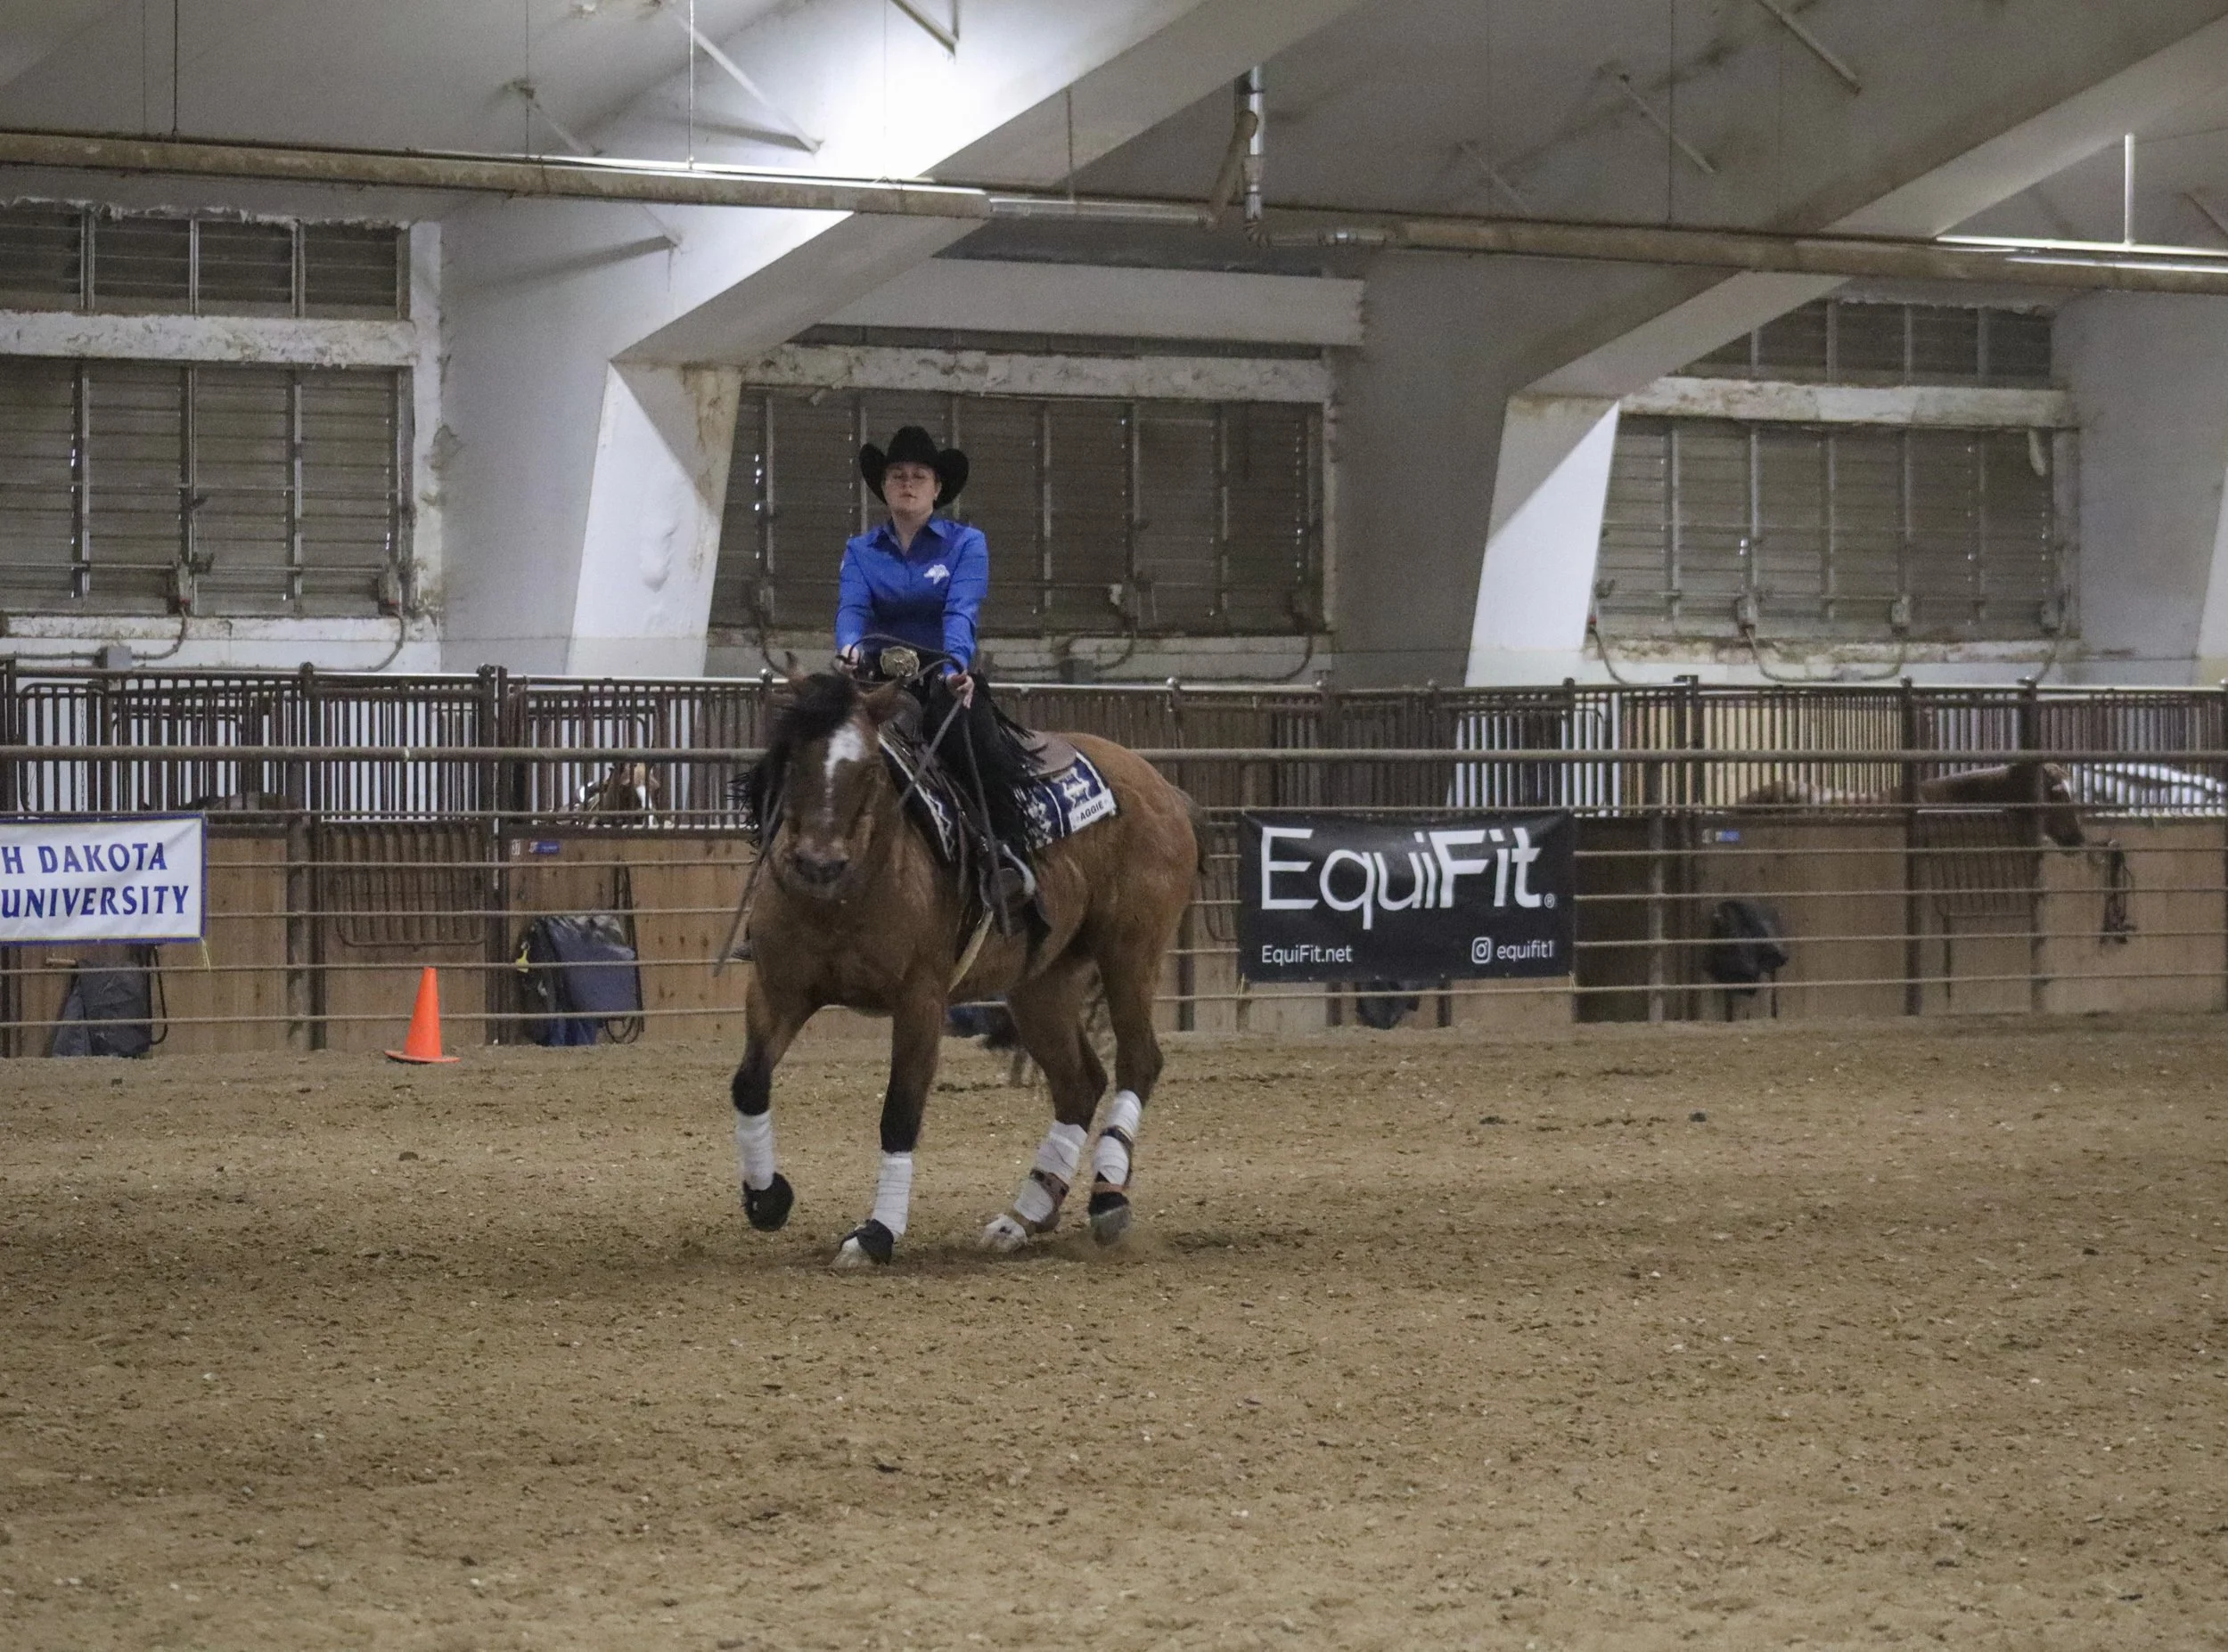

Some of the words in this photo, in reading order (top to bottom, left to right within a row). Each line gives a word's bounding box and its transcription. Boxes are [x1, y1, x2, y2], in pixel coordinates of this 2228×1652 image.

[1, 846, 25, 874] H
[37, 842, 168, 873] DAKOTA
[1, 885, 190, 919] UNIVERSITY
[1261, 945, 1353, 967] EquiFit.net
[1496, 940, 1554, 962] equifit1
